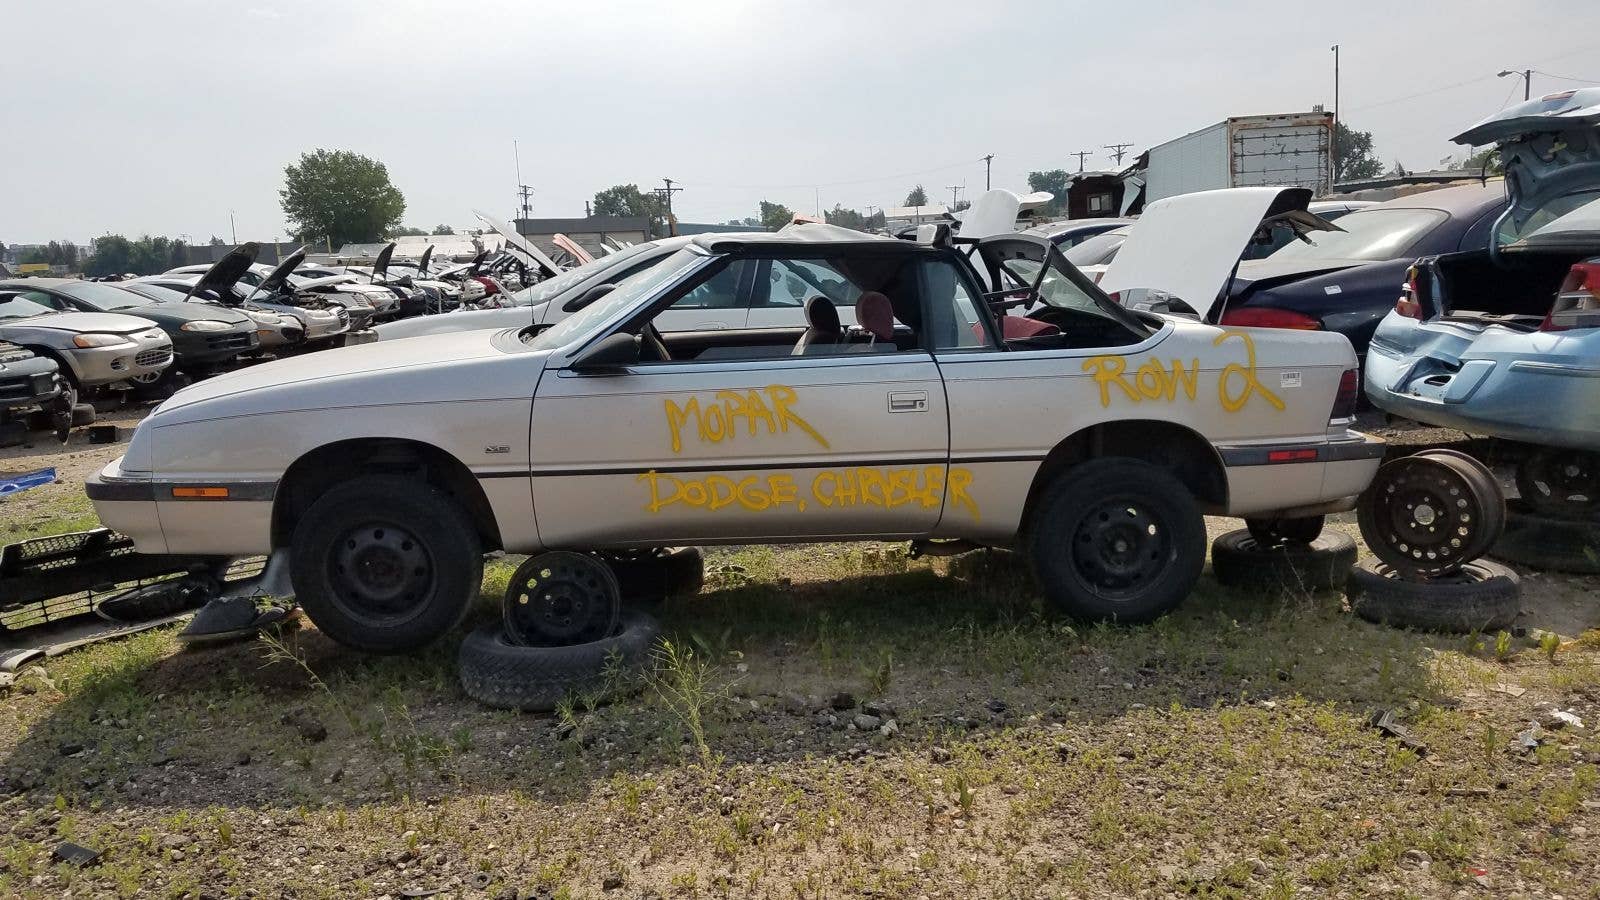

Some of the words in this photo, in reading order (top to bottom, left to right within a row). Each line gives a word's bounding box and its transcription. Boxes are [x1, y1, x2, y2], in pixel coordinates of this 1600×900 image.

[1082, 354, 1199, 407] ROW
[1213, 331, 1286, 413] 2
[664, 384, 831, 453] MOPAR
[636, 469, 808, 513] DODGE,
[810, 465, 981, 525] CHRYSLER
